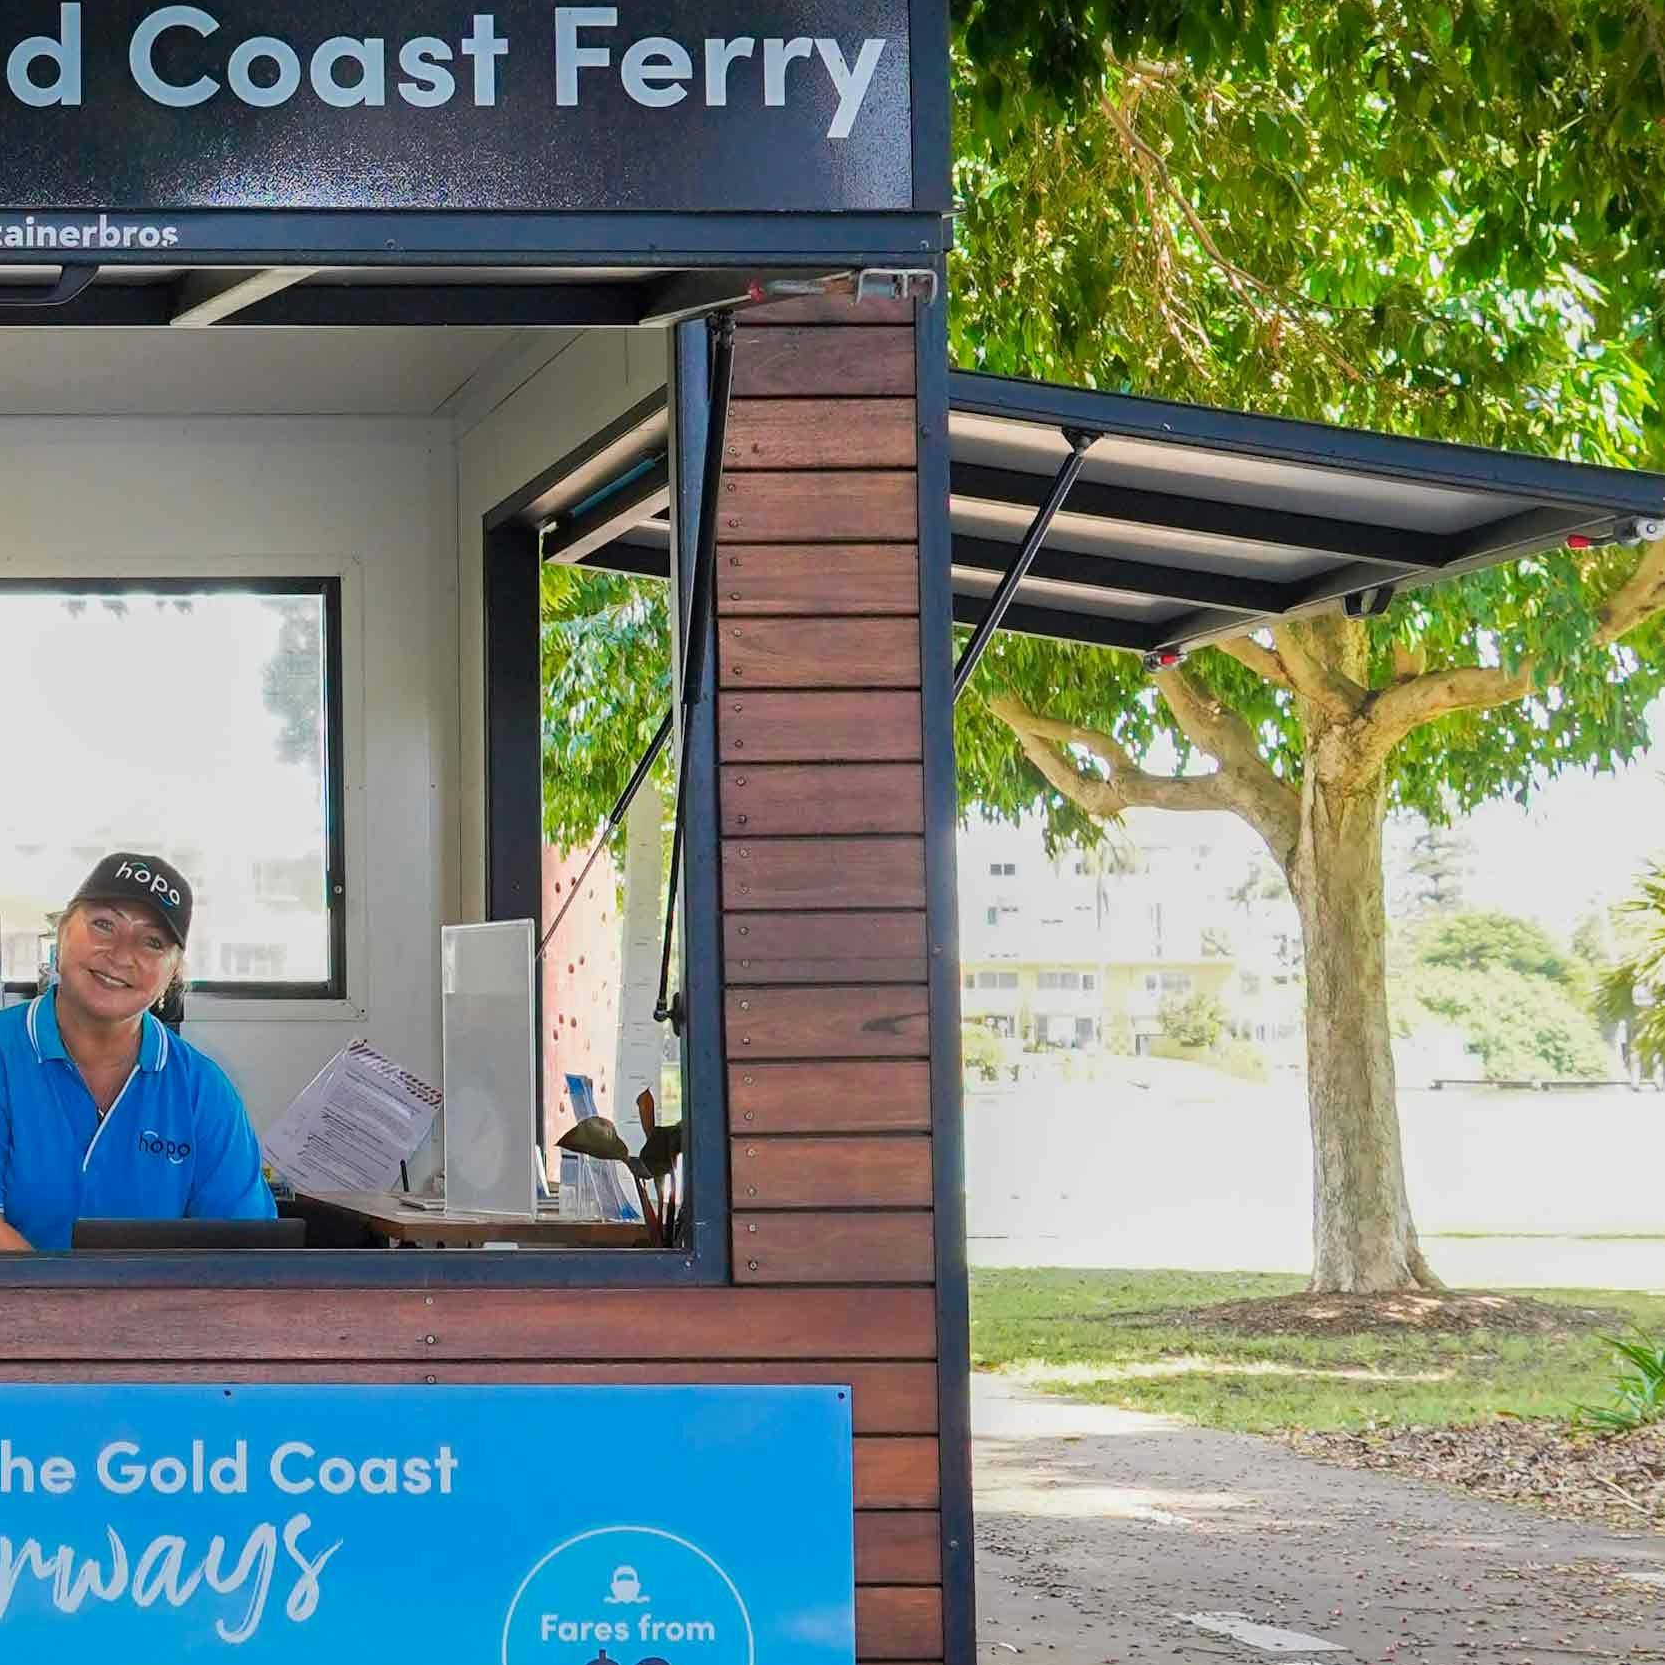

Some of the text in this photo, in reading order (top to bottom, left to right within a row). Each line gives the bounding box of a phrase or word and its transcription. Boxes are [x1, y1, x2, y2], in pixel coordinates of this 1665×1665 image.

[129, 4, 509, 109] Coast
[555, 6, 887, 138] Ferry
[115, 861, 181, 906] hopo
[138, 1129, 192, 1161] hopo
[97, 1439, 247, 1495] Gold
[270, 1442, 459, 1496] Coast
[541, 1614, 715, 1642] Fares from
